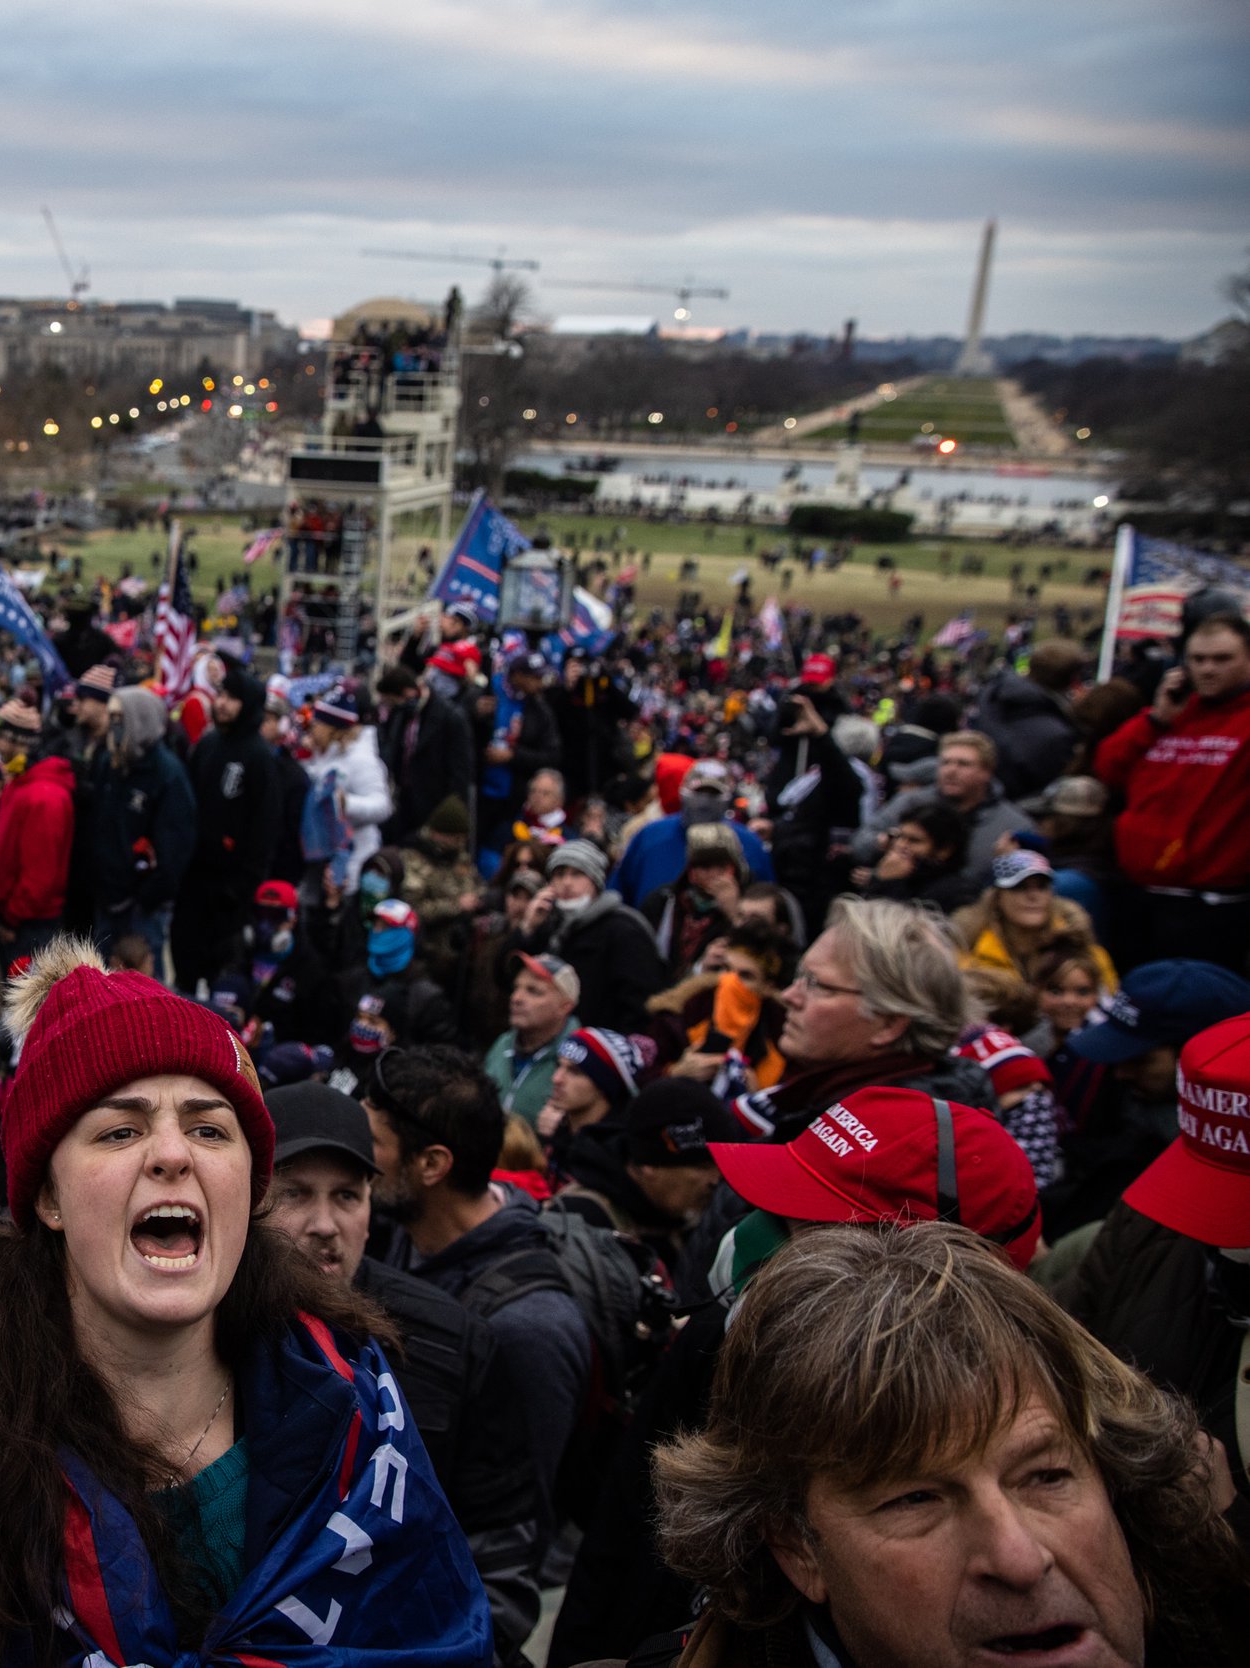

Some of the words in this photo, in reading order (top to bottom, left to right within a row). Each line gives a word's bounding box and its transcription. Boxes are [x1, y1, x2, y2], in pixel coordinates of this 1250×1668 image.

[1184, 1080, 1250, 1119] AMER
[812, 1121, 855, 1158] AGAIN
[1201, 1121, 1250, 1155] AGA
